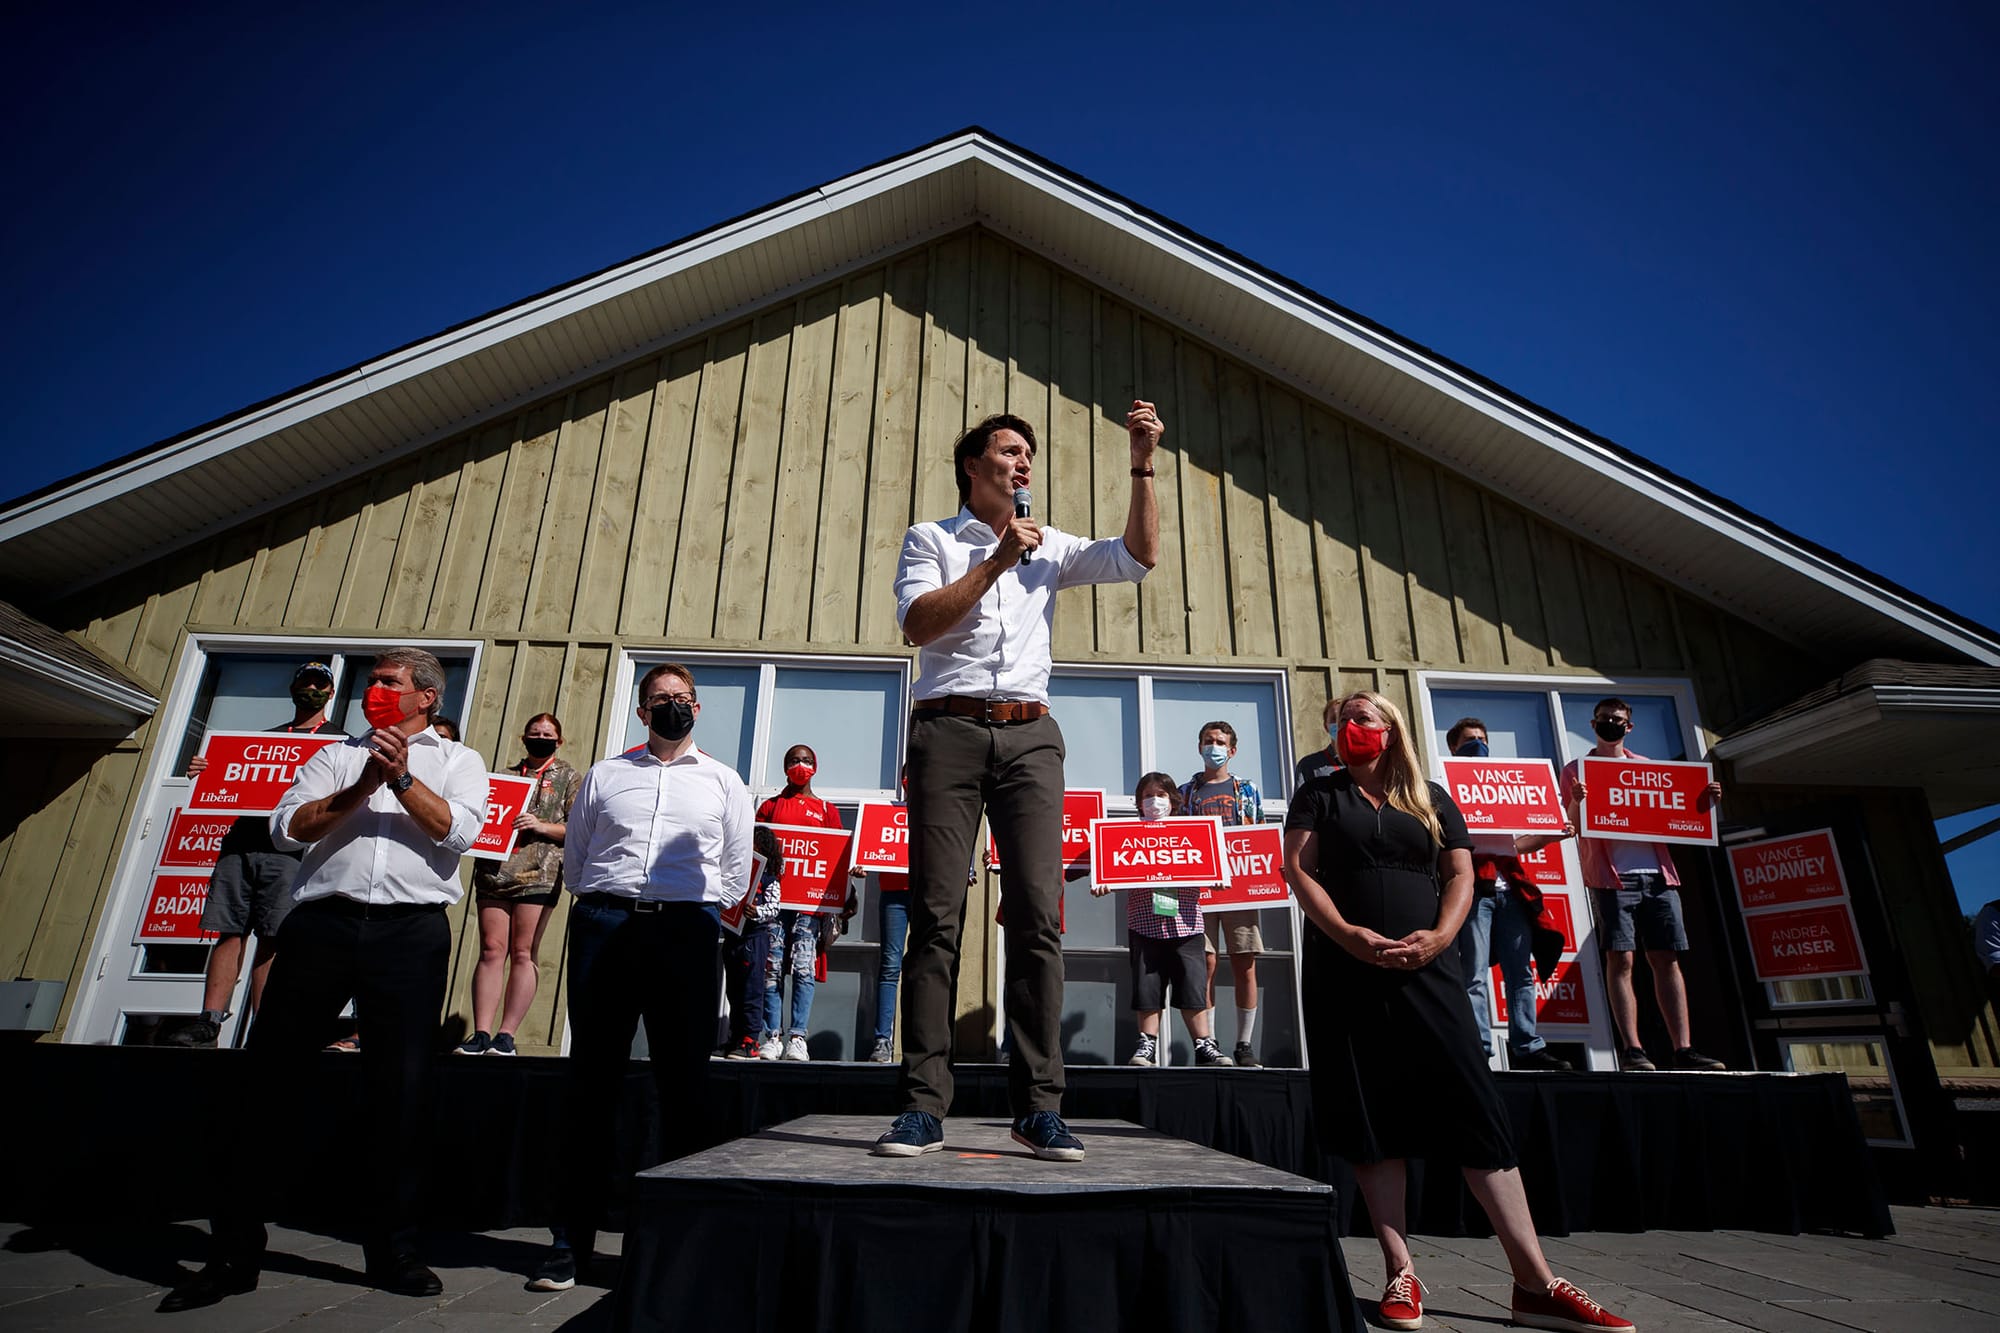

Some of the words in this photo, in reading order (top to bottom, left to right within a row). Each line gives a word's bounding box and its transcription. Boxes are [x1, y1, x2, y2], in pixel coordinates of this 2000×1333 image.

[243, 744, 302, 762] CHRIS
[223, 763, 304, 783] BITTL
[1473, 769, 1526, 784] VANCE
[1619, 770, 1674, 788] CHRIS
[200, 792, 239, 803] Liberal
[1457, 784, 1547, 805] BADAWEY
[1608, 788, 1686, 810] BITTLE
[1463, 813, 1495, 823] Liberal
[1526, 816, 1558, 824] TRUDEAU
[1594, 815, 1629, 827] Liberal
[188, 824, 232, 835] ANDR
[1668, 822, 1705, 832] TRUDEAU
[178, 836, 223, 851] KAIS
[475, 837, 502, 846] UDEAU
[776, 837, 819, 856] HRIS
[1121, 837, 1193, 849] ANDREA
[863, 851, 896, 861] Liberal
[1113, 849, 1203, 866] KAISER
[1757, 844, 1806, 864] VANCE
[1743, 856, 1826, 886] BADAWEY
[179, 883, 209, 896] VAN
[1247, 887, 1281, 896] TRUDEAU
[1771, 925, 1831, 942] ANDREA
[1772, 940, 1837, 957] KAISER
